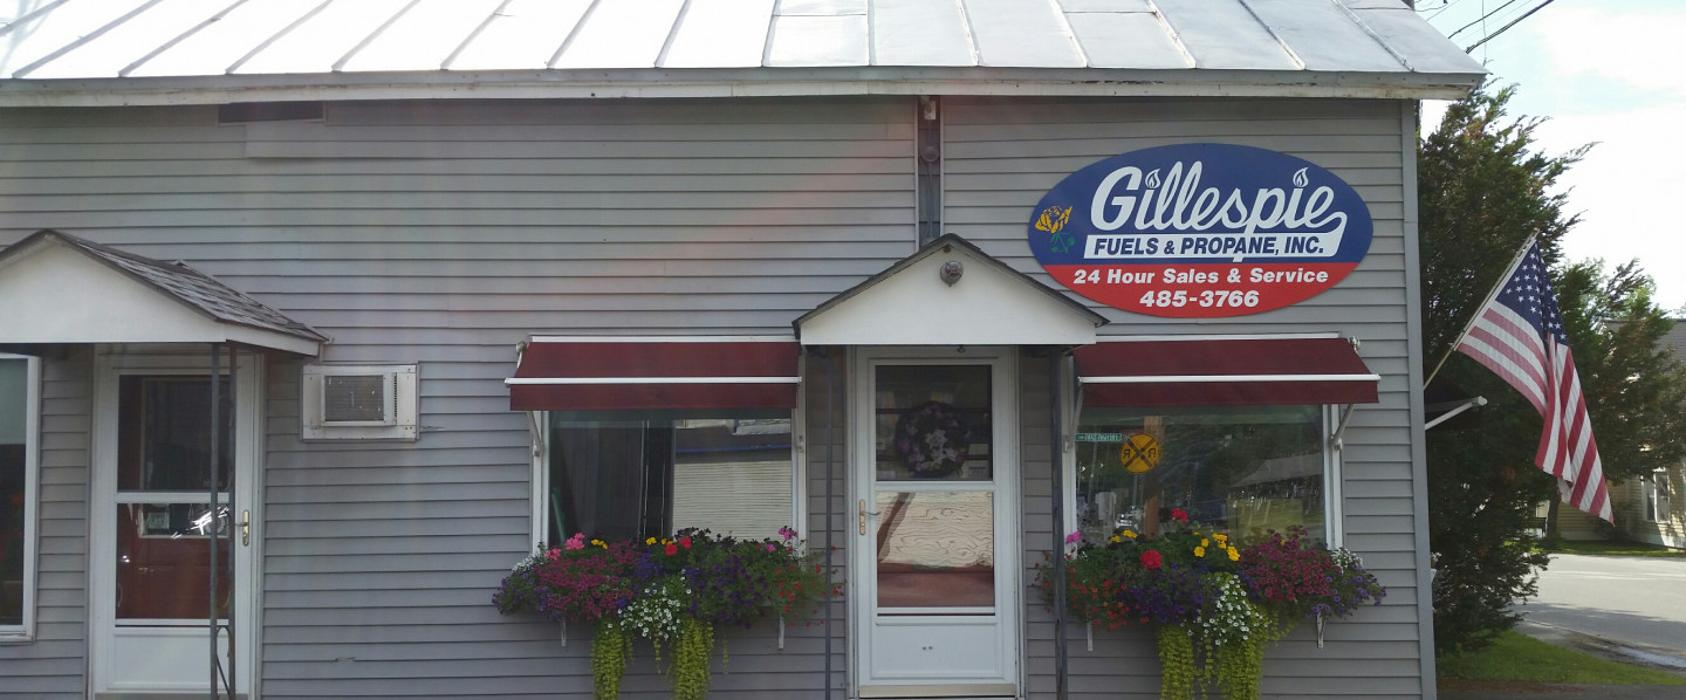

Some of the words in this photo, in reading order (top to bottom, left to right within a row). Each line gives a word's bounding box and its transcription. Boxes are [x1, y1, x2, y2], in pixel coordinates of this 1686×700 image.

[1090, 160, 1348, 240] Gillespie
[1094, 237, 1159, 256] FUELS
[1163, 239, 1175, 255] &
[1180, 236, 1280, 256] PROPANE,
[1284, 236, 1324, 254] INC.
[1073, 269, 1100, 284] 24
[1107, 269, 1155, 284] Hour
[1162, 268, 1219, 284] Sales
[1226, 268, 1242, 283] &
[1249, 267, 1329, 283] Service
[1139, 290, 1260, 308] 485-3766
